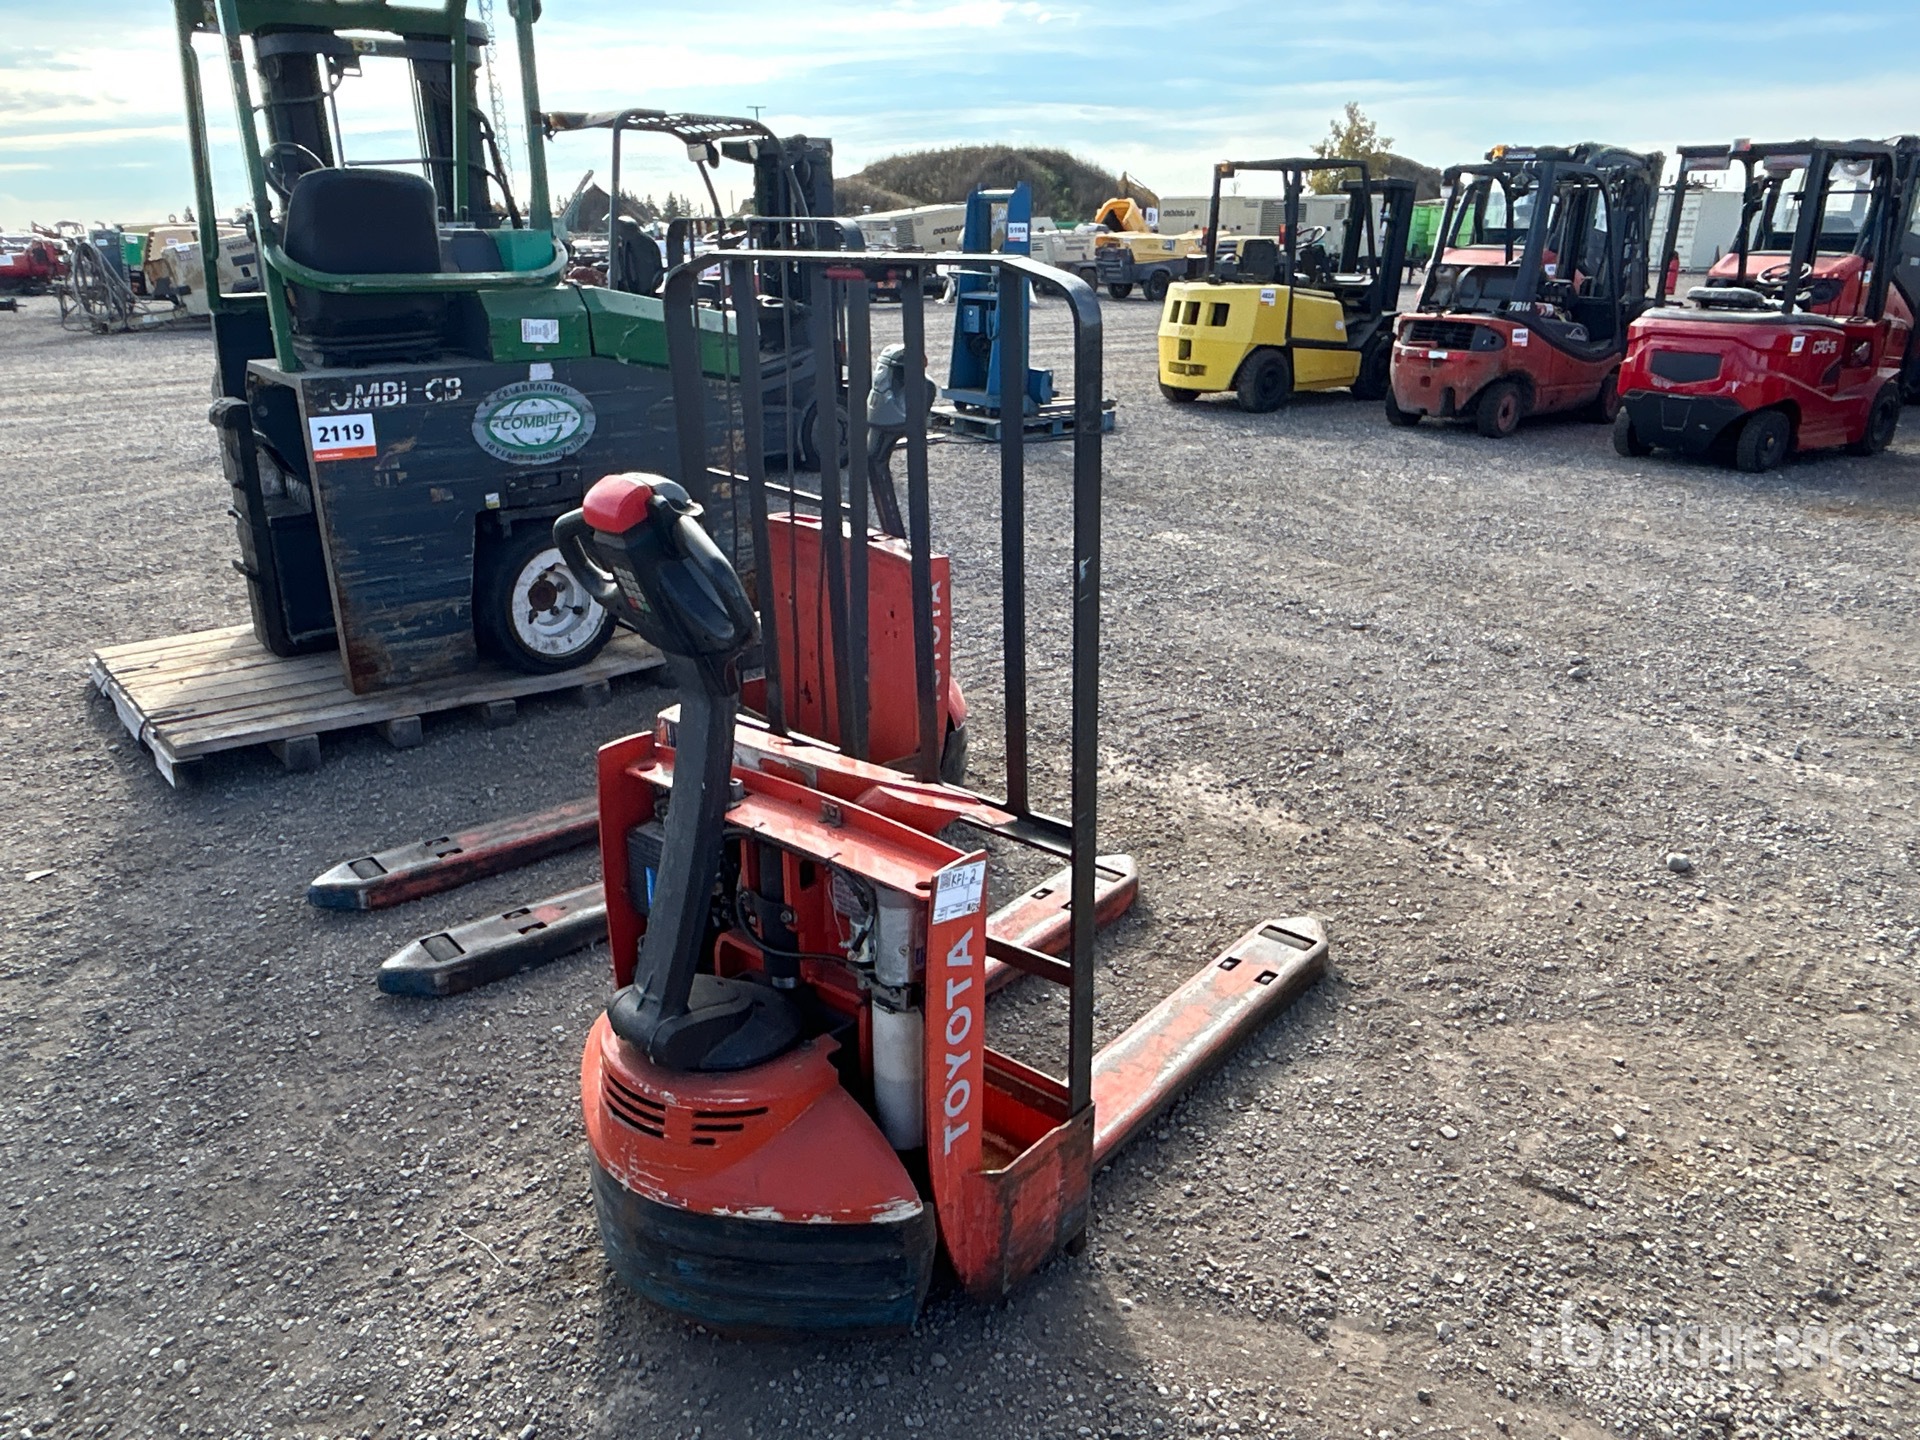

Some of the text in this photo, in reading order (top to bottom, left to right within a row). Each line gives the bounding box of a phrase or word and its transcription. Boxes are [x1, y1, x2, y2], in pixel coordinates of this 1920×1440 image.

[496, 383, 568, 400] CELEBRATING
[318, 423, 364, 443] 2119
[944, 927, 974, 1156] TOYOTA
